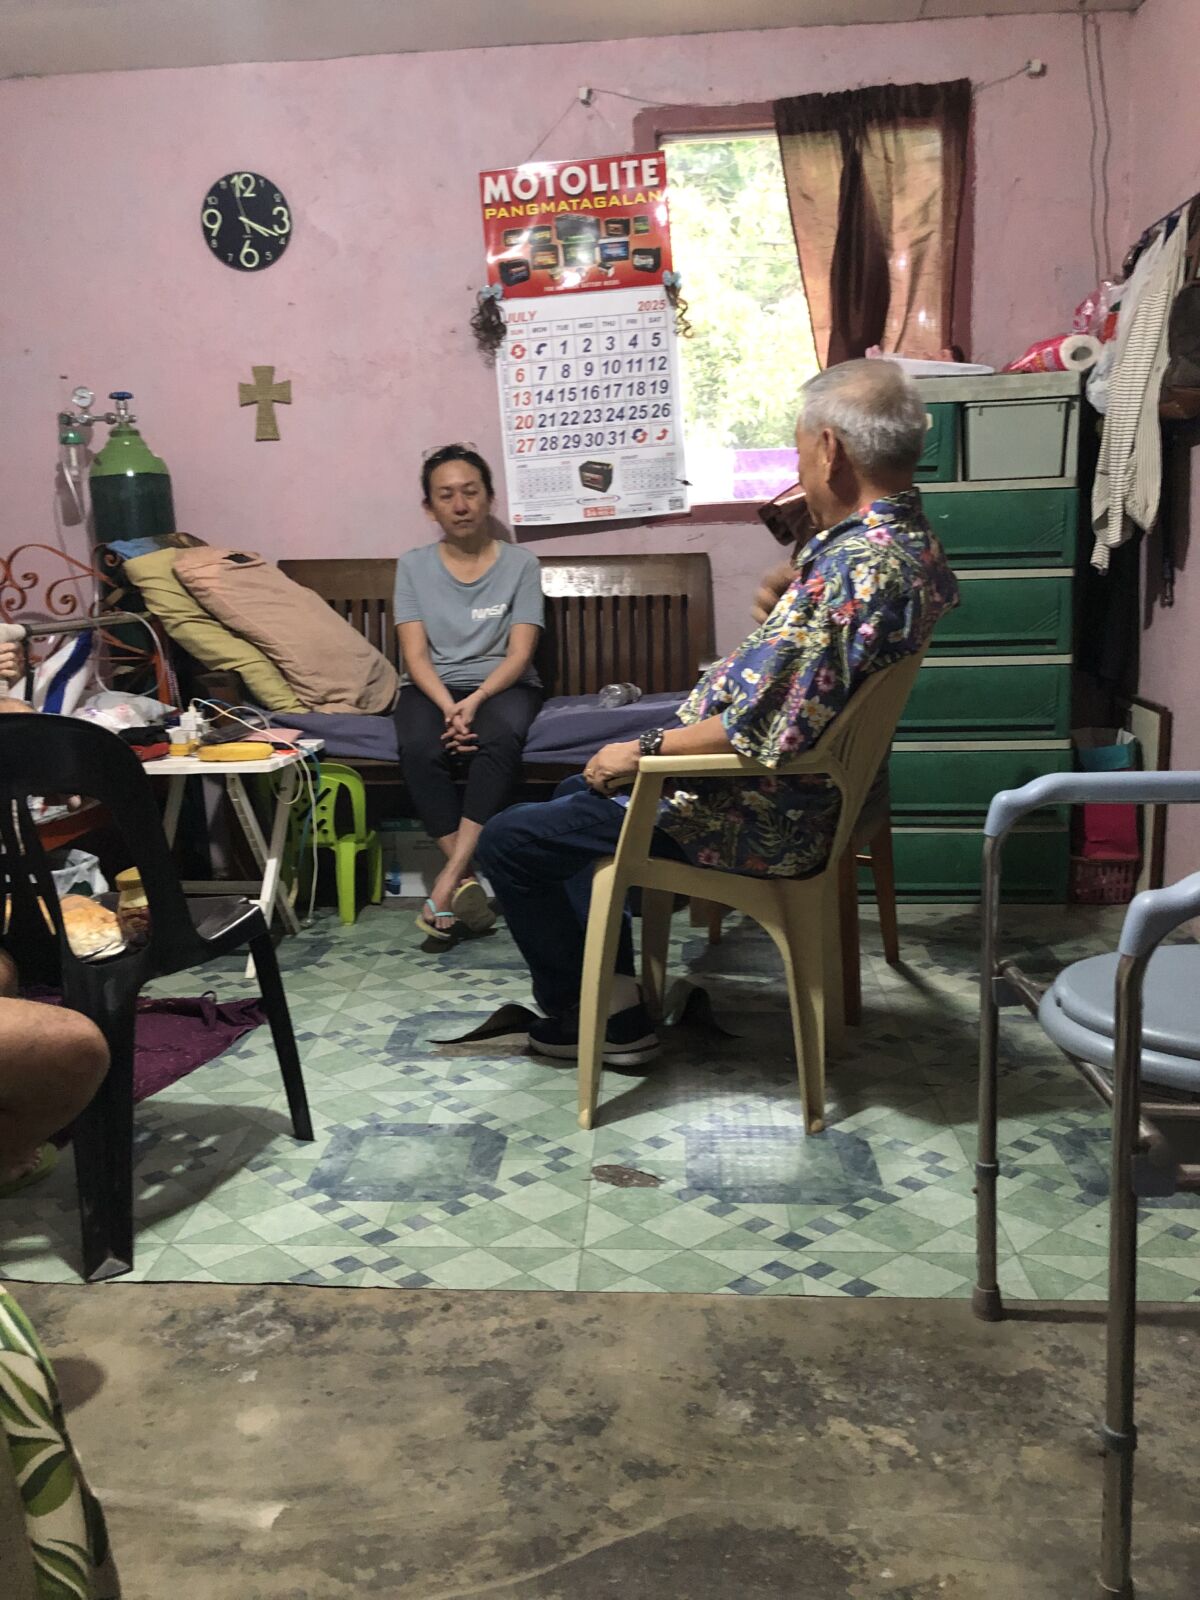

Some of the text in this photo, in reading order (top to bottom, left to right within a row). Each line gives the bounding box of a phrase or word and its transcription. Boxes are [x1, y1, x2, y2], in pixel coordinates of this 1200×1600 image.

[230, 174, 256, 197] 12
[484, 158, 660, 204] MOTOLITE
[485, 190, 662, 219] PANGMATAGALAN
[203, 209, 222, 236] 9
[272, 207, 290, 234] 3
[240, 240, 259, 267] 6
[505, 311, 536, 323] JULY
[638, 300, 666, 312] 2025
[560, 333, 660, 354] 1 2 3 4 5
[516, 356, 667, 382] 6 7 8 9 10 11 12
[513, 380, 669, 406] 13 14 15 16 17 18 19
[515, 403, 671, 429] 20 21 22 23 24 25 26
[517, 430, 626, 453] 27 28 29 30 31
